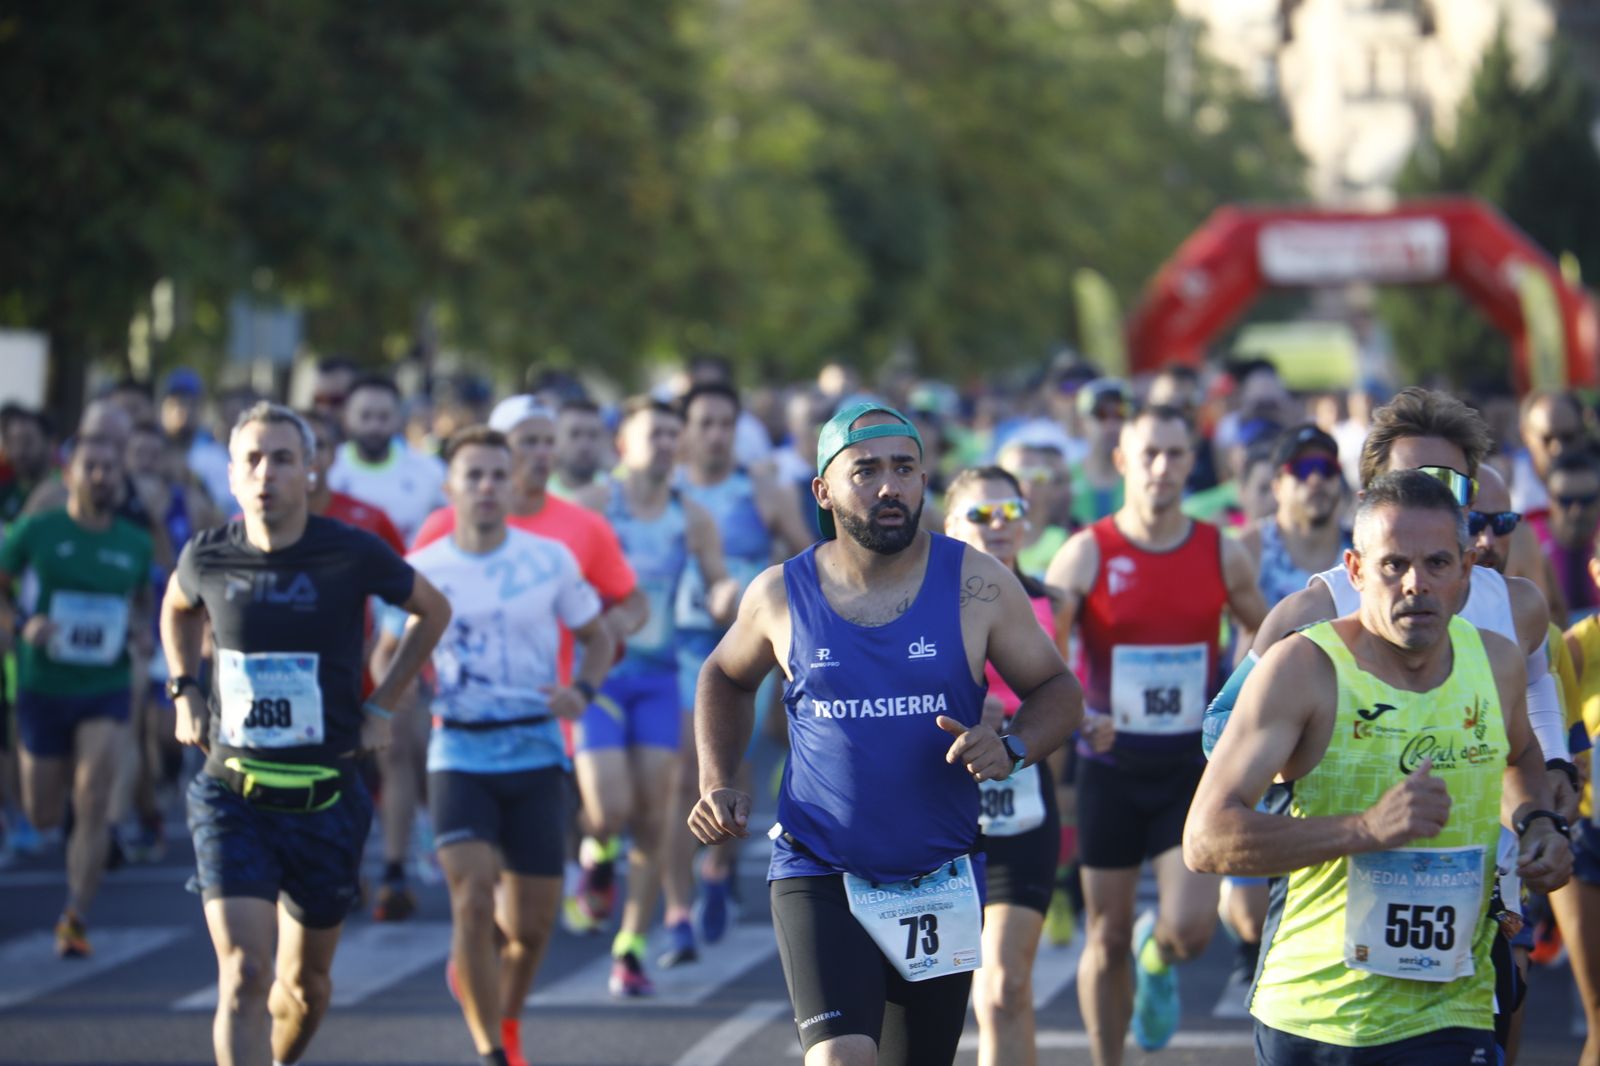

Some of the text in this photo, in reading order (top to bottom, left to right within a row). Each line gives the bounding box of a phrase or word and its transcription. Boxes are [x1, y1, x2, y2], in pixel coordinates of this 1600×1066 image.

[225, 571, 318, 603] FILA
[812, 693, 947, 718] TROTASIERRA
[1356, 868, 1408, 886] MEDIA
[854, 890, 901, 905] MEDIA
[899, 913, 939, 960] 73
[1385, 903, 1455, 951] 553
[794, 1009, 842, 1029] ROTASIERRA
